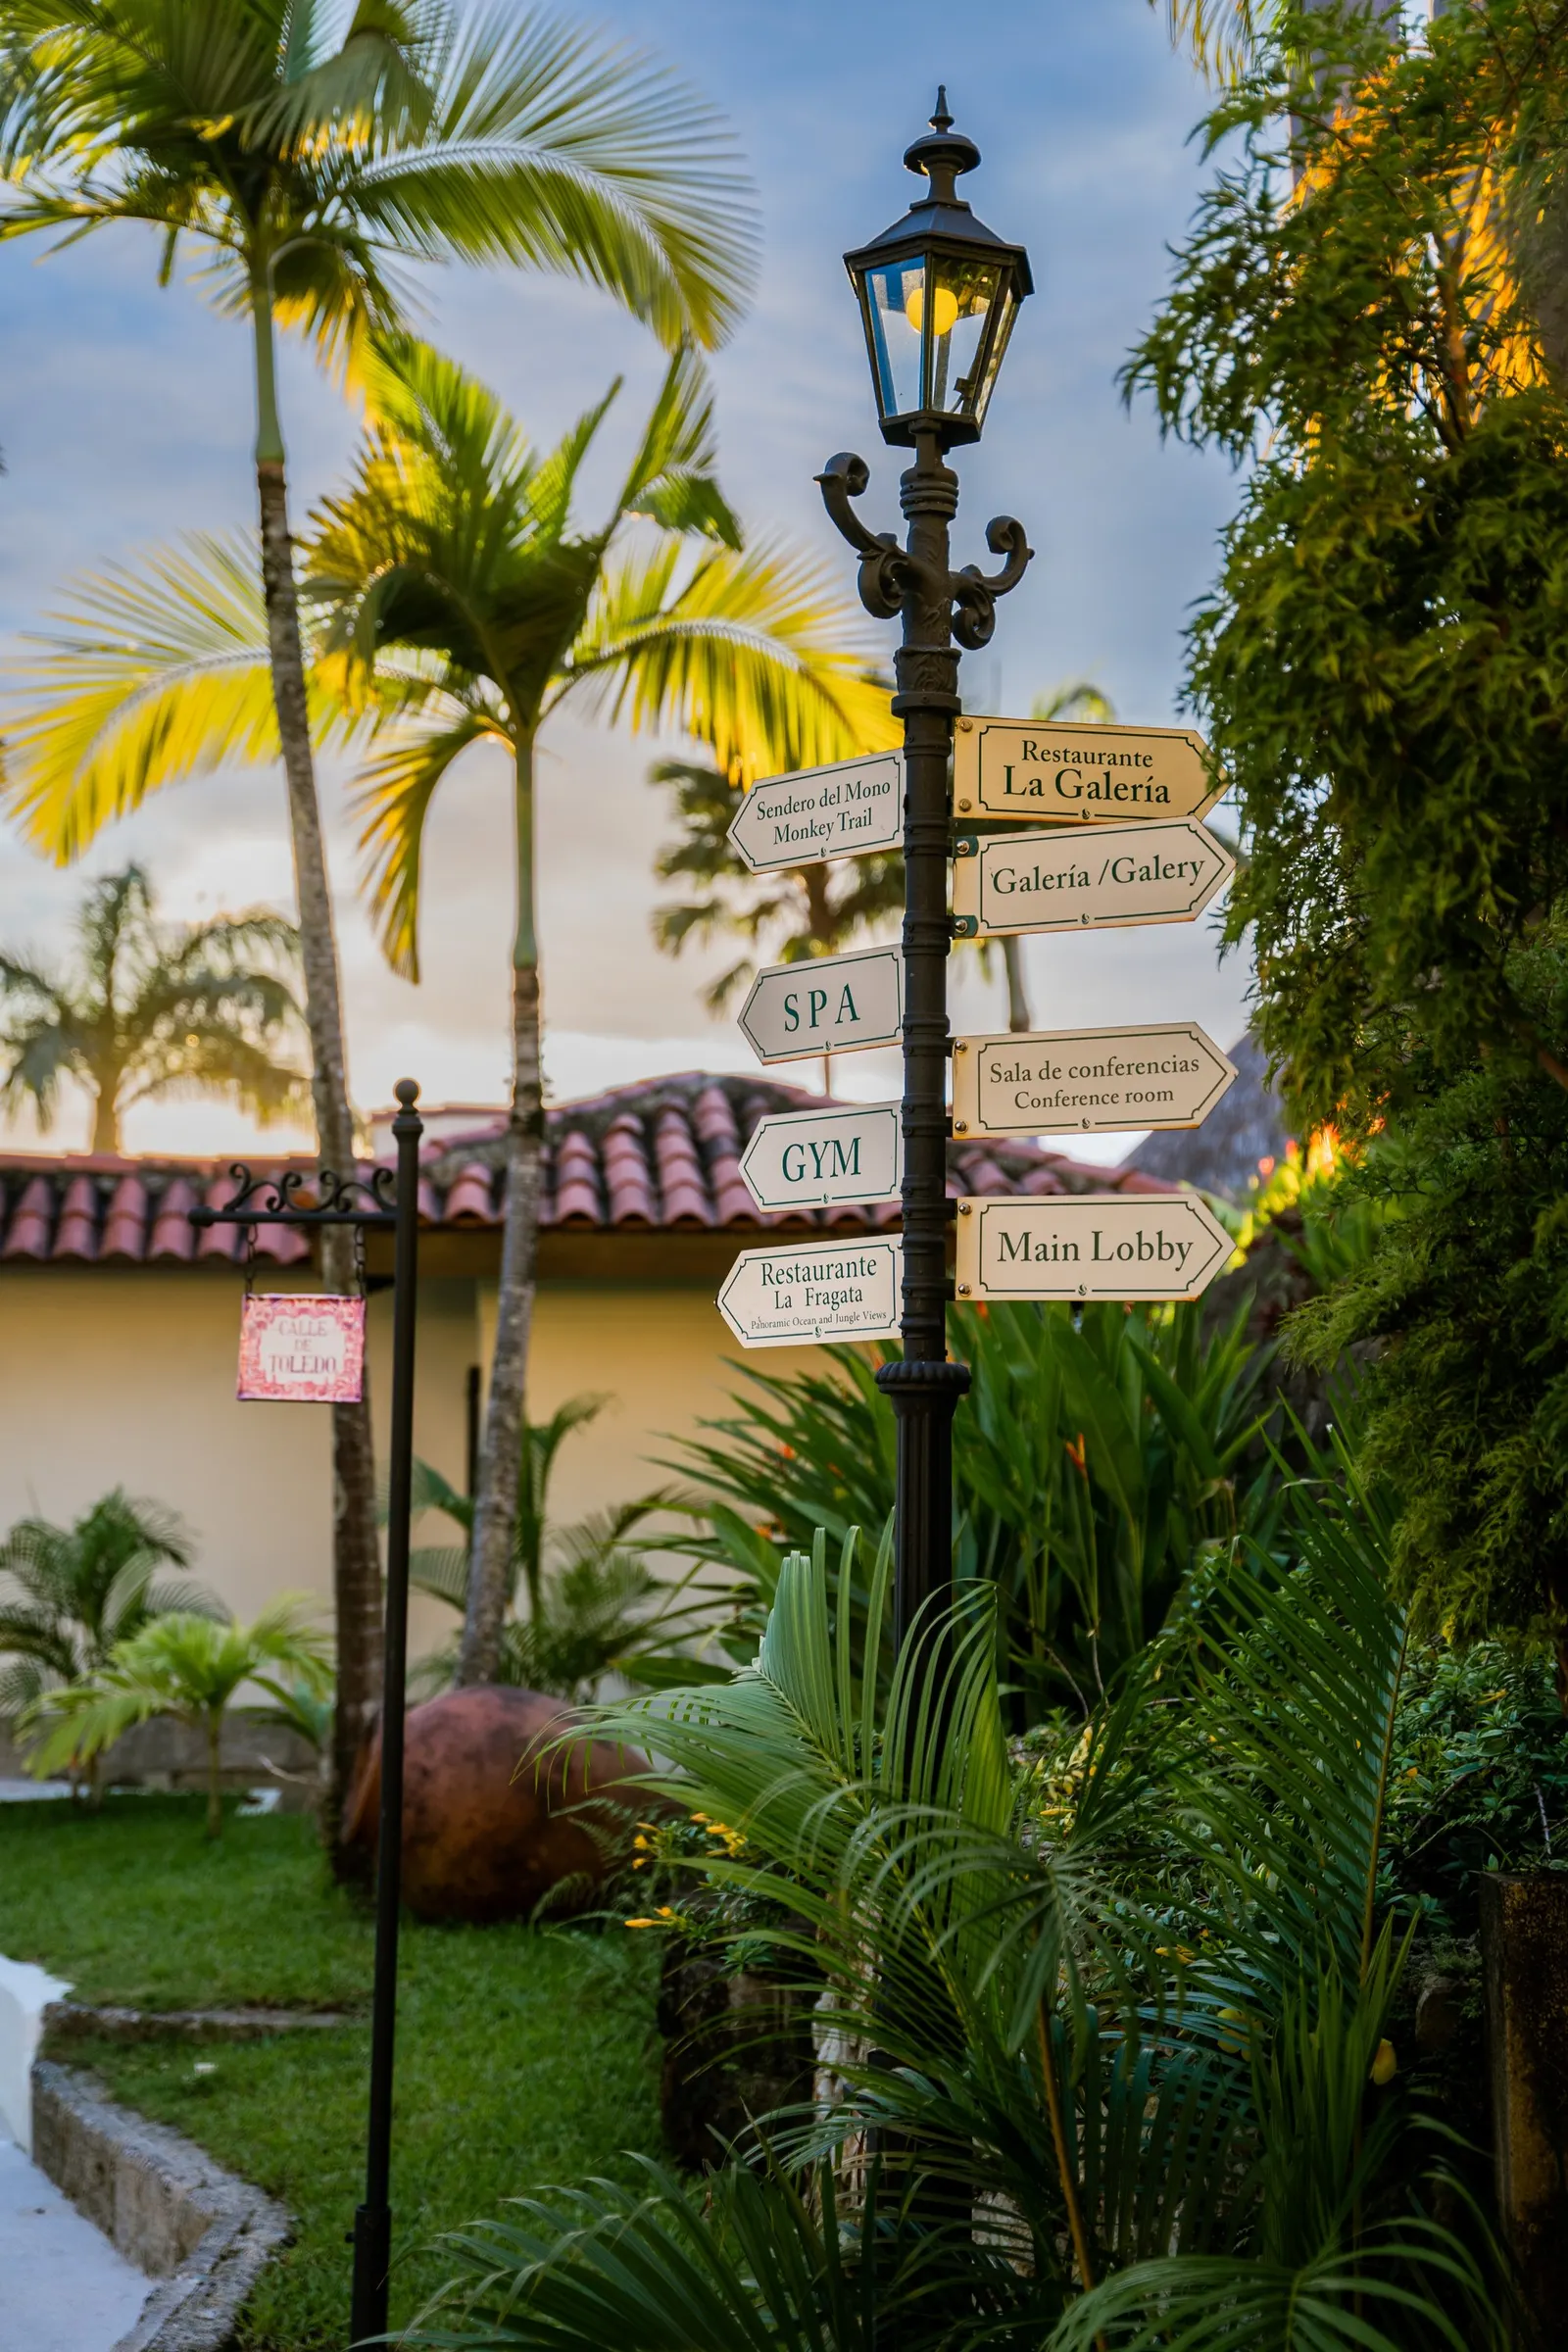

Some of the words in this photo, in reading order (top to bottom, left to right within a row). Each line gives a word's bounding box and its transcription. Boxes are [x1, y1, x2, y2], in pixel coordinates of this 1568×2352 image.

[1022, 740, 1153, 767] Restaurante
[757, 796, 815, 820] Sendero
[818, 789, 841, 805] del
[845, 779, 891, 802] Mono
[1004, 765, 1043, 796] La
[1055, 768, 1171, 804] Galería
[773, 821, 834, 845] Monkey
[837, 807, 872, 830] Trail
[993, 864, 1091, 894] Galería
[784, 983, 860, 1032] SPA
[990, 1062, 1032, 1084] Sala
[1039, 1060, 1062, 1080] de
[1068, 1055, 1200, 1078] conferencias
[1014, 1090, 1120, 1109] Conference
[1125, 1088, 1174, 1102] room
[782, 1137, 861, 1182] GYM
[998, 1232, 1080, 1262] Main
[1092, 1231, 1194, 1271] Lobby
[760, 1255, 877, 1285] Restaurante
[774, 1291, 792, 1308] La
[805, 1287, 863, 1311] Fragata
[751, 1317, 790, 1329] Panoramic
[793, 1315, 816, 1327] Ocean
[818, 1313, 833, 1324] and
[835, 1312, 860, 1325] Jungle
[862, 1310, 887, 1321] Views
